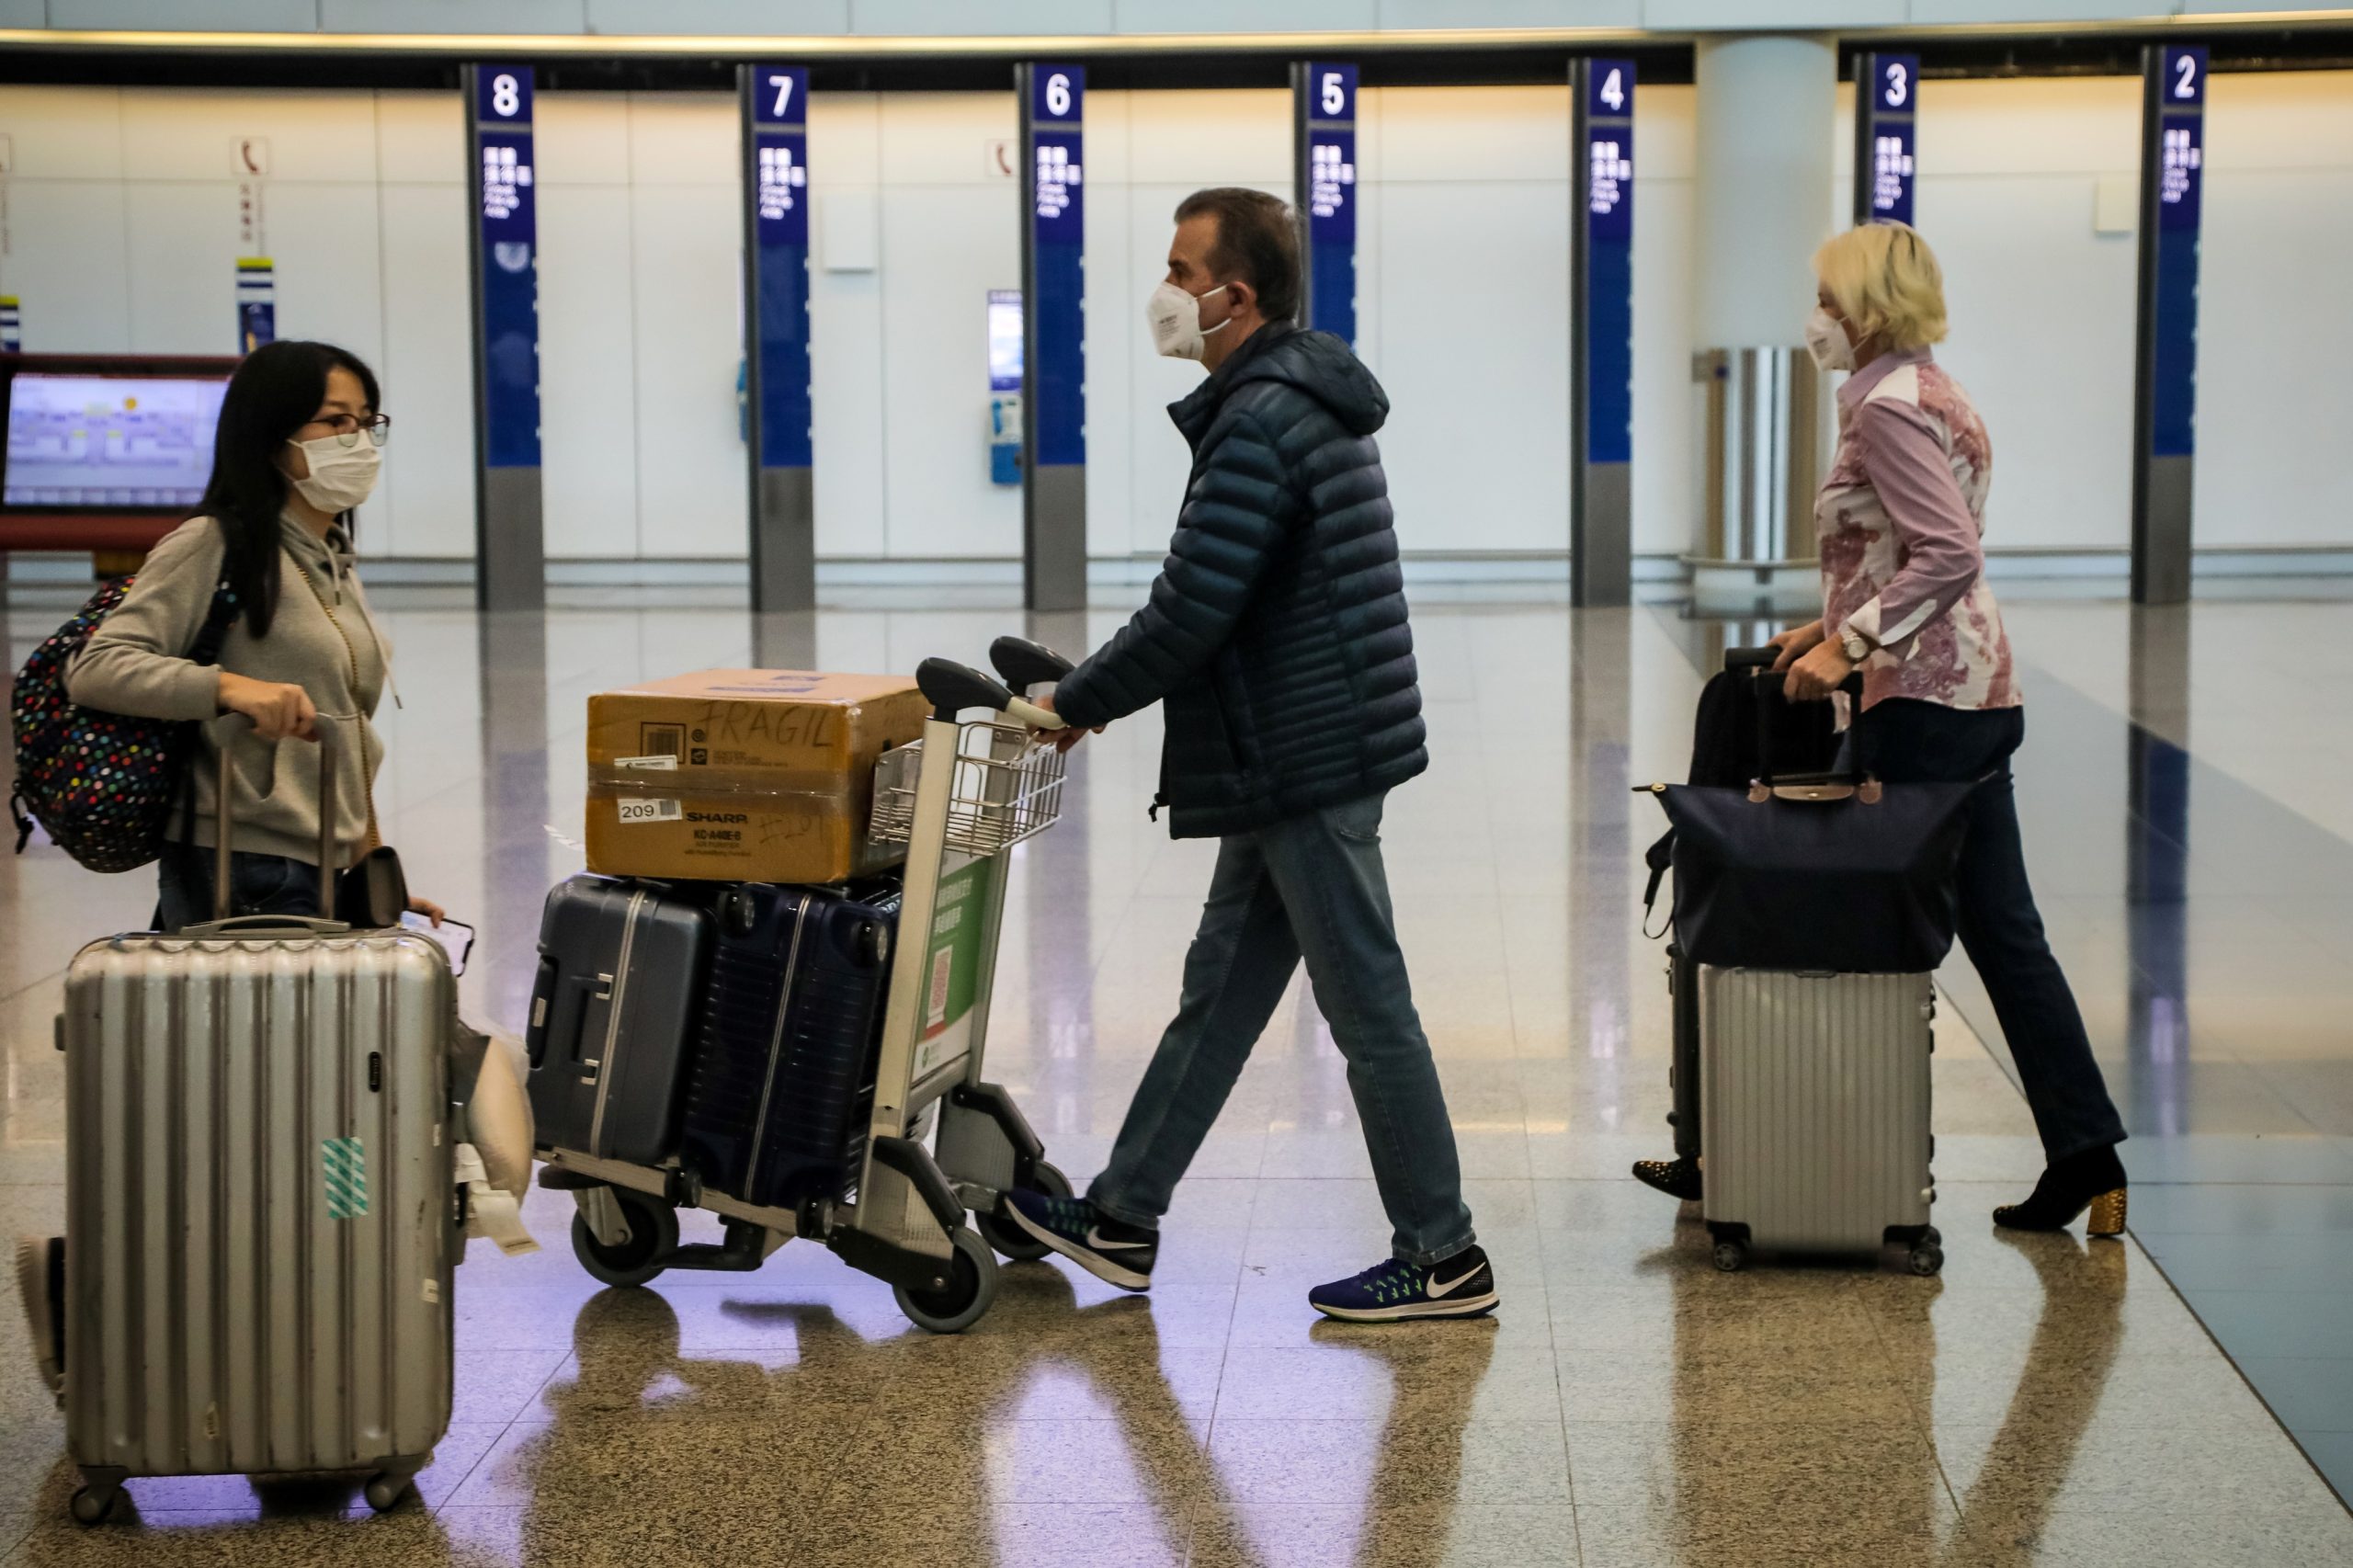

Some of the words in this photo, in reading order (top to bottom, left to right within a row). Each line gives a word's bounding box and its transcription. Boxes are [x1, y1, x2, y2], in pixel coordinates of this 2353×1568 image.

[493, 74, 519, 117] 8
[768, 75, 793, 117] 7
[1046, 74, 1071, 116] 6
[1322, 73, 1345, 115] 5
[1600, 68, 1624, 110] 4
[1885, 62, 1907, 107] 3
[2175, 54, 2196, 98] 2
[621, 804, 654, 818] 209
[687, 812, 748, 824] SHARP
